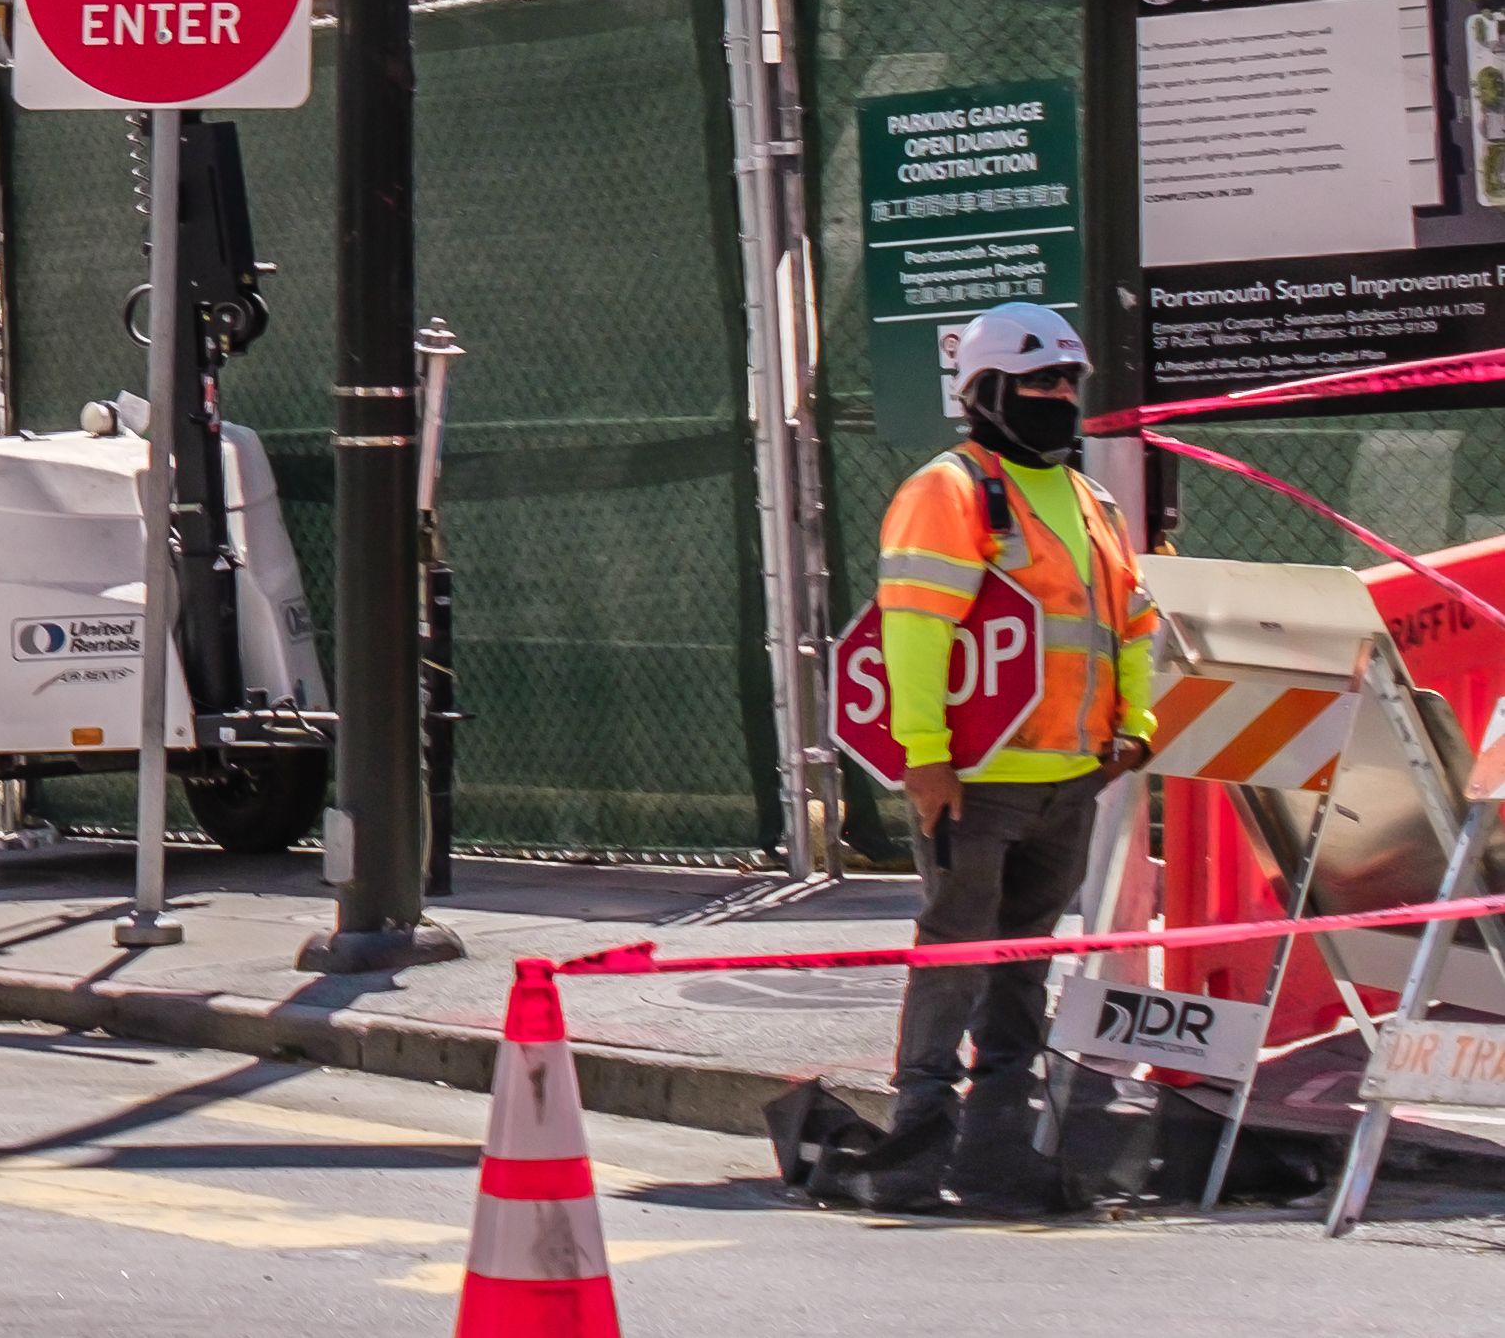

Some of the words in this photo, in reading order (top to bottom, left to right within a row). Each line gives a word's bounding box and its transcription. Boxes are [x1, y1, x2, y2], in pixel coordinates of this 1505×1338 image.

[82, 3, 241, 46] ENTER
[887, 109, 966, 135] PARKING
[968, 102, 1044, 126] GARAGE
[904, 135, 954, 157] OPEN
[956, 128, 1028, 153] DURING
[897, 152, 1037, 183] CONSTRUCTION
[1151, 281, 1271, 308] Portsmouth
[1275, 280, 1345, 305] Square
[1351, 270, 1491, 299] Improvement
[70, 620, 136, 636] United
[70, 636, 140, 653] Rentals
[845, 616, 1028, 724] SOP
[1138, 995, 1215, 1045] DR
